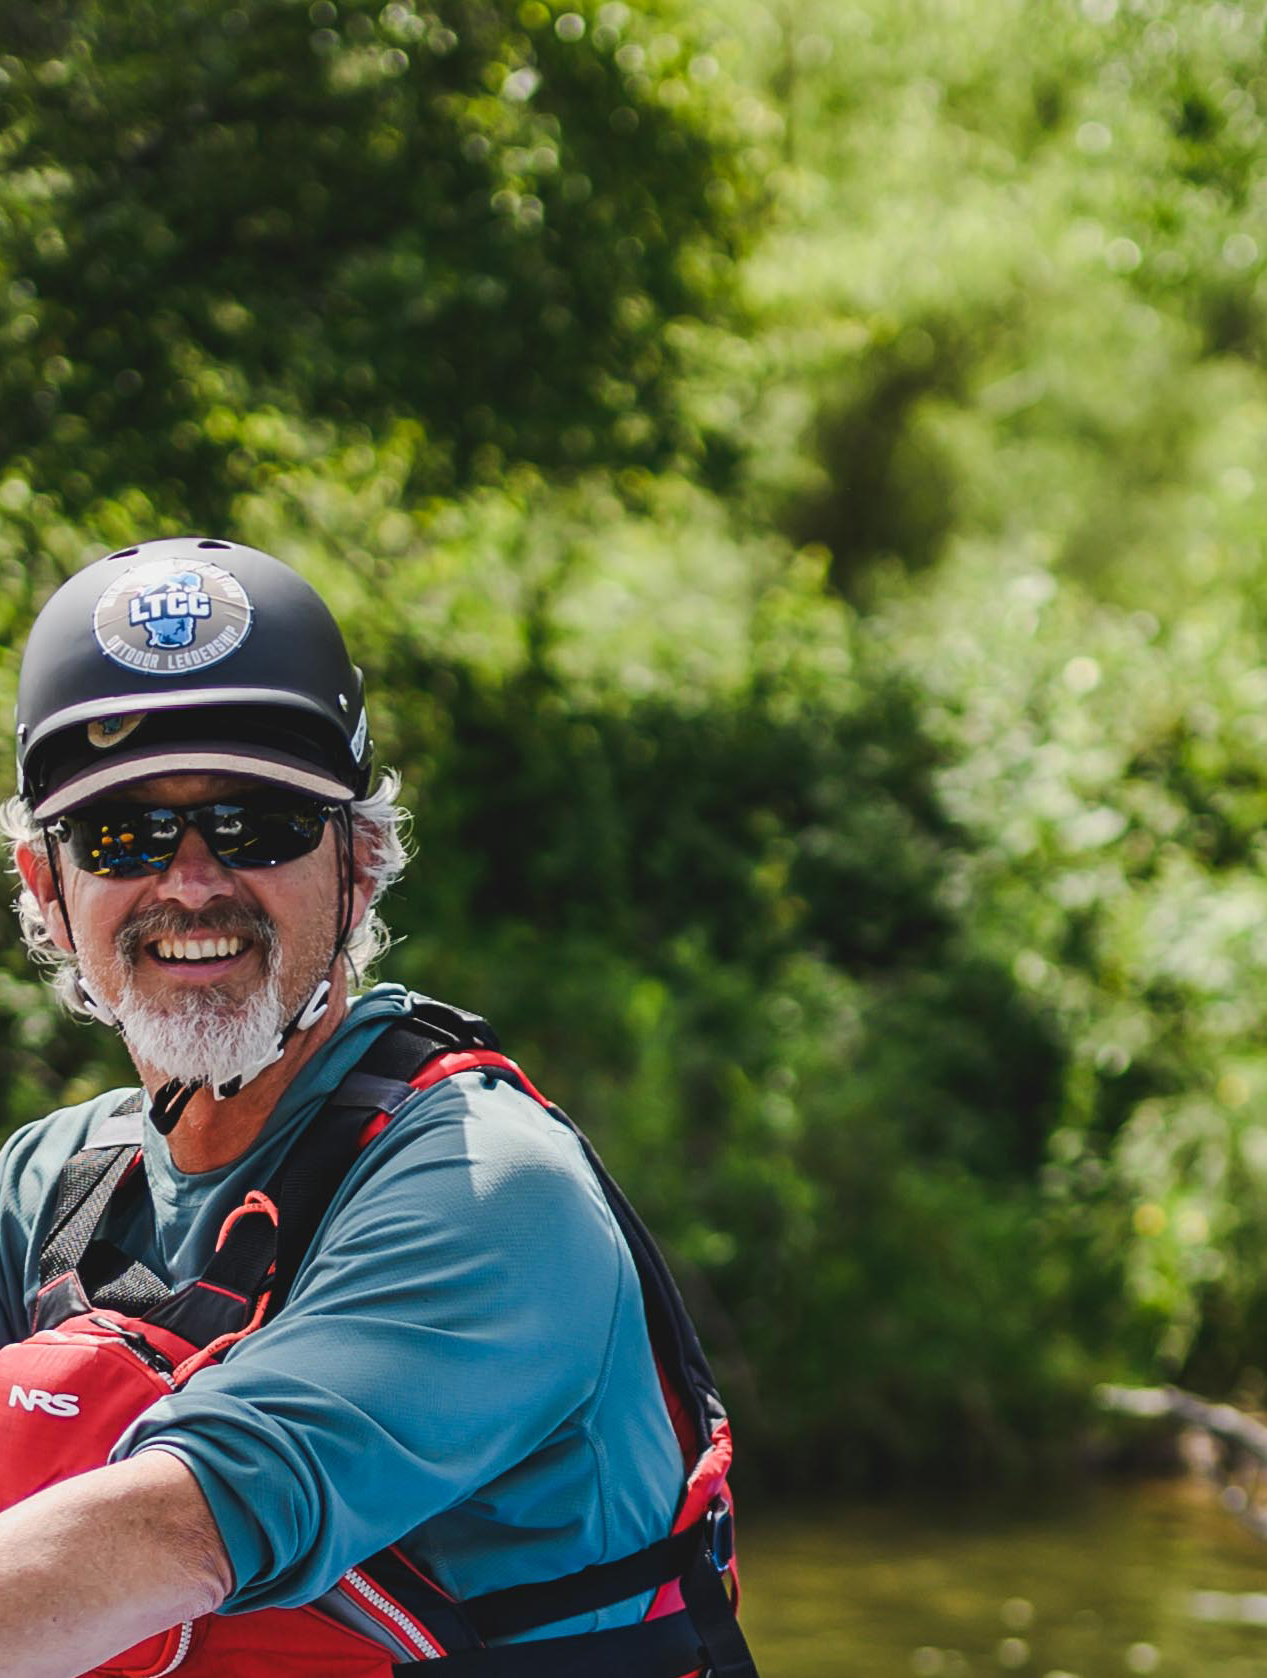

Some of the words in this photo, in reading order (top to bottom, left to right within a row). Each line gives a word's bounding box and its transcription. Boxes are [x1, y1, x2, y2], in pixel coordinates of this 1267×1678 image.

[130, 591, 210, 624] LTCC
[106, 633, 160, 669] OUTDOOR
[167, 624, 240, 670] LEADERSHIP
[8, 1384, 81, 1417] NRS
